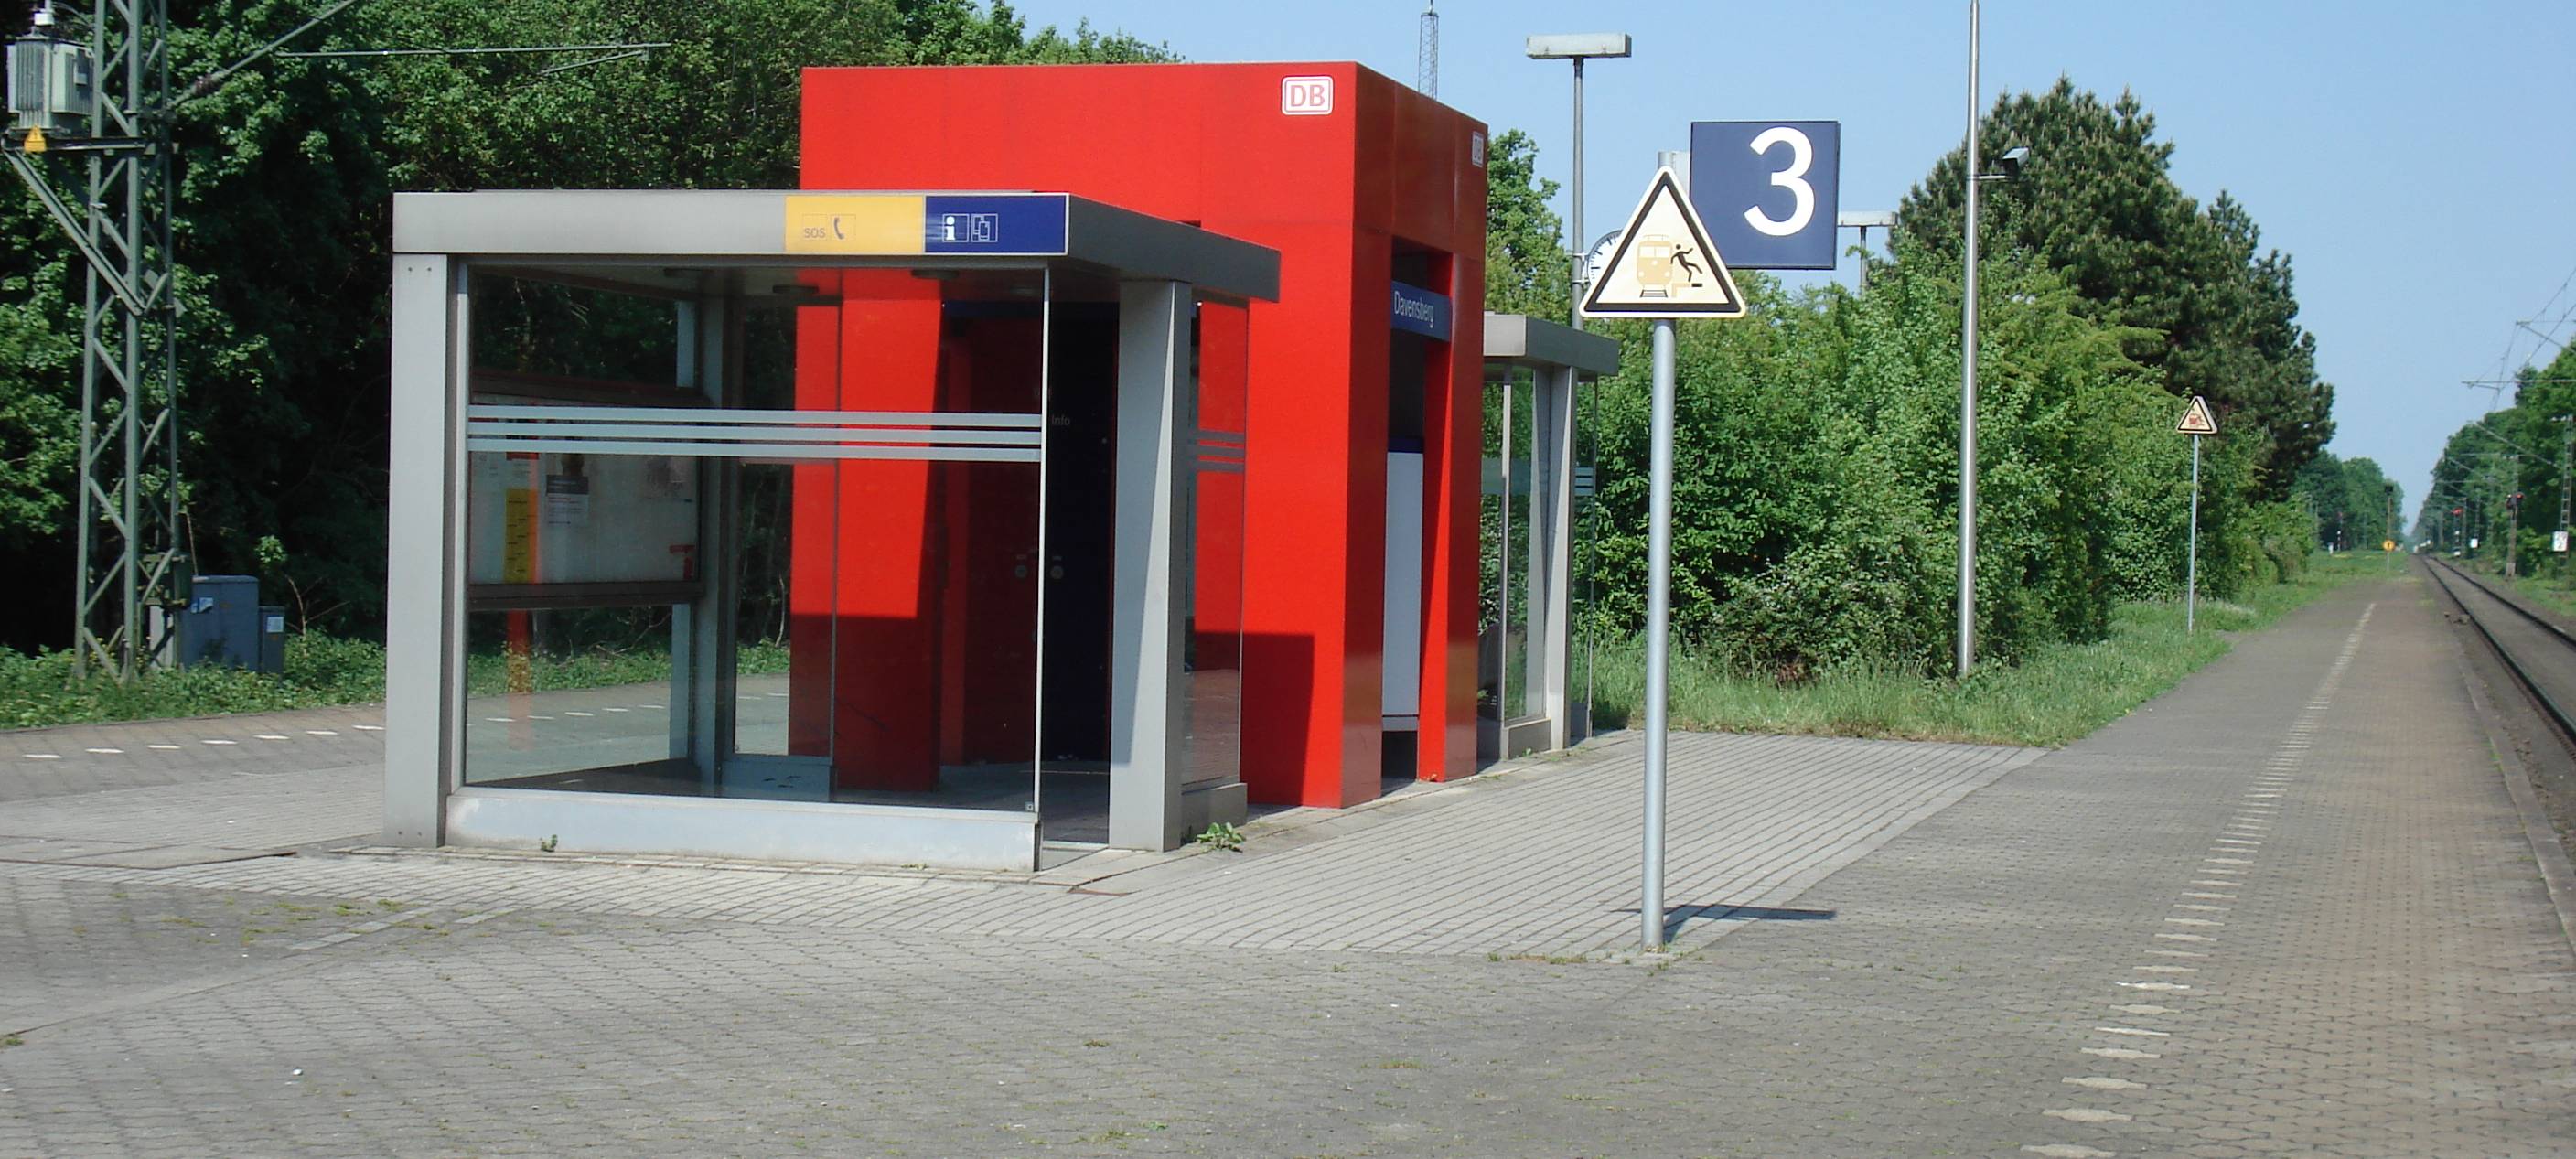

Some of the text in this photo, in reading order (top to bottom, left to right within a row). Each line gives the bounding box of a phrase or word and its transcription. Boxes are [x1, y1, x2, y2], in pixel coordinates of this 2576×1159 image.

[1290, 84, 1326, 107] DB
[1744, 126, 1816, 237] 3
[804, 227, 827, 239] SOS
[1393, 290, 1435, 329] Davensberg
[1051, 414, 1071, 426] Info
